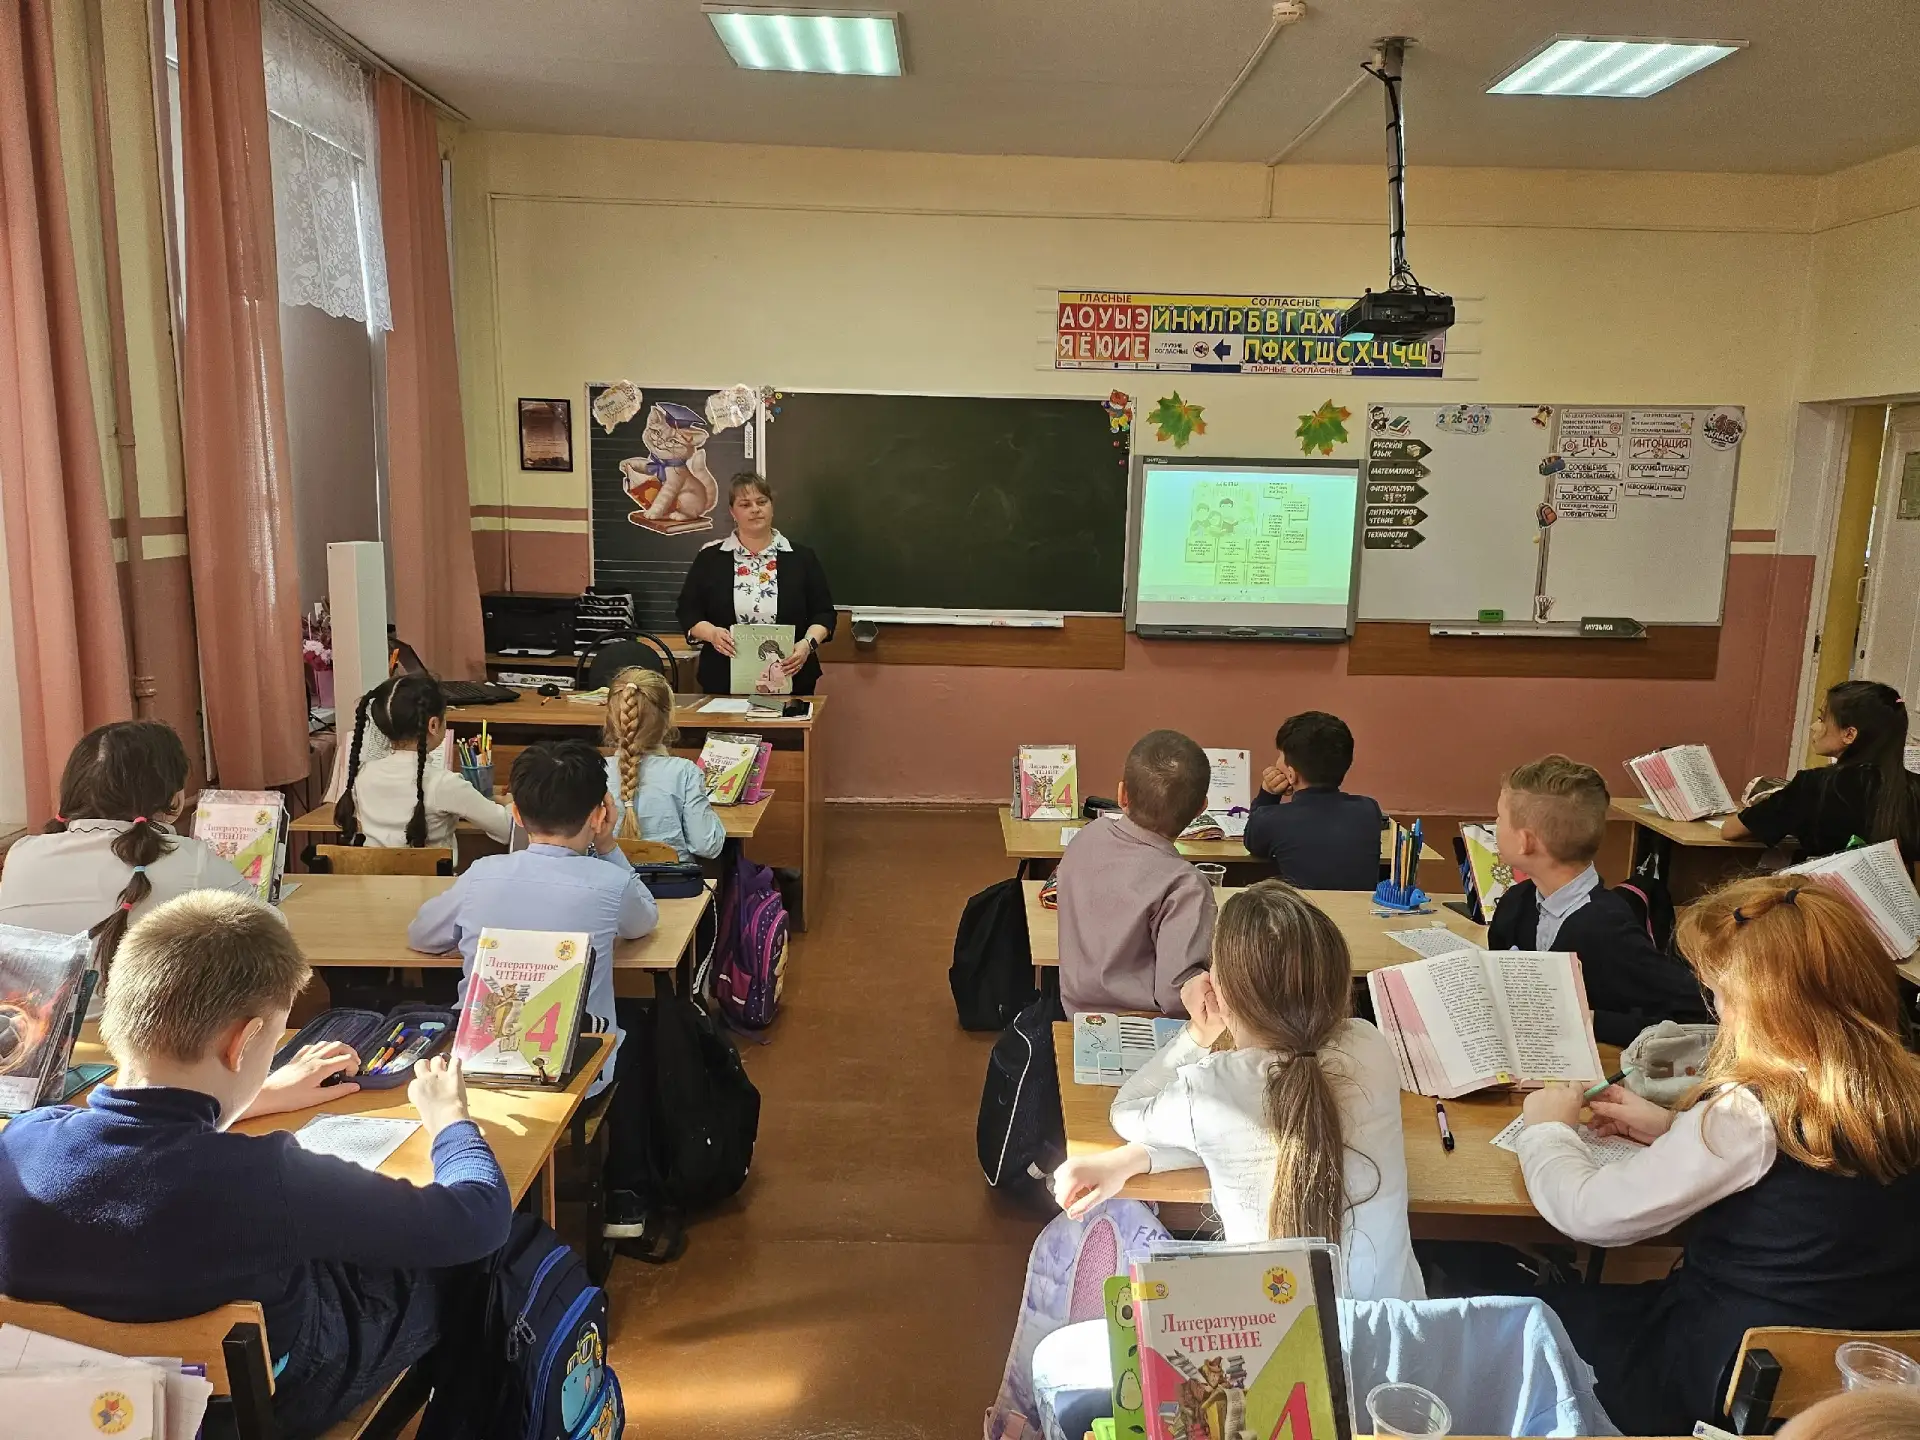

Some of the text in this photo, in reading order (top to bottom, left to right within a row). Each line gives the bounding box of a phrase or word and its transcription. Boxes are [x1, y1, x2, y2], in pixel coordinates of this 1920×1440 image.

[1079, 293, 1132, 303] ГЛАСНЫЕ
[1251, 297, 1320, 307] СОГЛАСНЫЕ
[1251, 365, 1343, 375] ПАРНЫЕ СОГЛАСНЫЕ
[1372, 440, 1403, 449] РУССКИЙ
[1582, 438, 1608, 449] ЦЕЛЬ
[1633, 438, 1688, 449] ИНТОНАЦИЯ
[1372, 450, 1392, 458] ЯЗЫК
[1370, 467, 1415, 475] МАТЕМАТИКА
[1369, 485, 1415, 493] ФИЗКУЛЬТУРА
[1573, 485, 1601, 493] ВОПРОС
[1368, 508, 1418, 516] ЛИТЕРАТУРНОЕ
[1367, 531, 1409, 539] ТЕХНОЛОГИЯ
[1584, 623, 1614, 631] МУЗЫКА
[718, 773, 739, 795] 4
[1056, 784, 1073, 807] 4
[486, 956, 559, 973] Литературное
[495, 969, 546, 982] ЧТЕНИЕ
[524, 1001, 562, 1053] 4
[1161, 1311, 1277, 1334] Литературное
[1180, 1331, 1262, 1353] ЧТЕНИЕ
